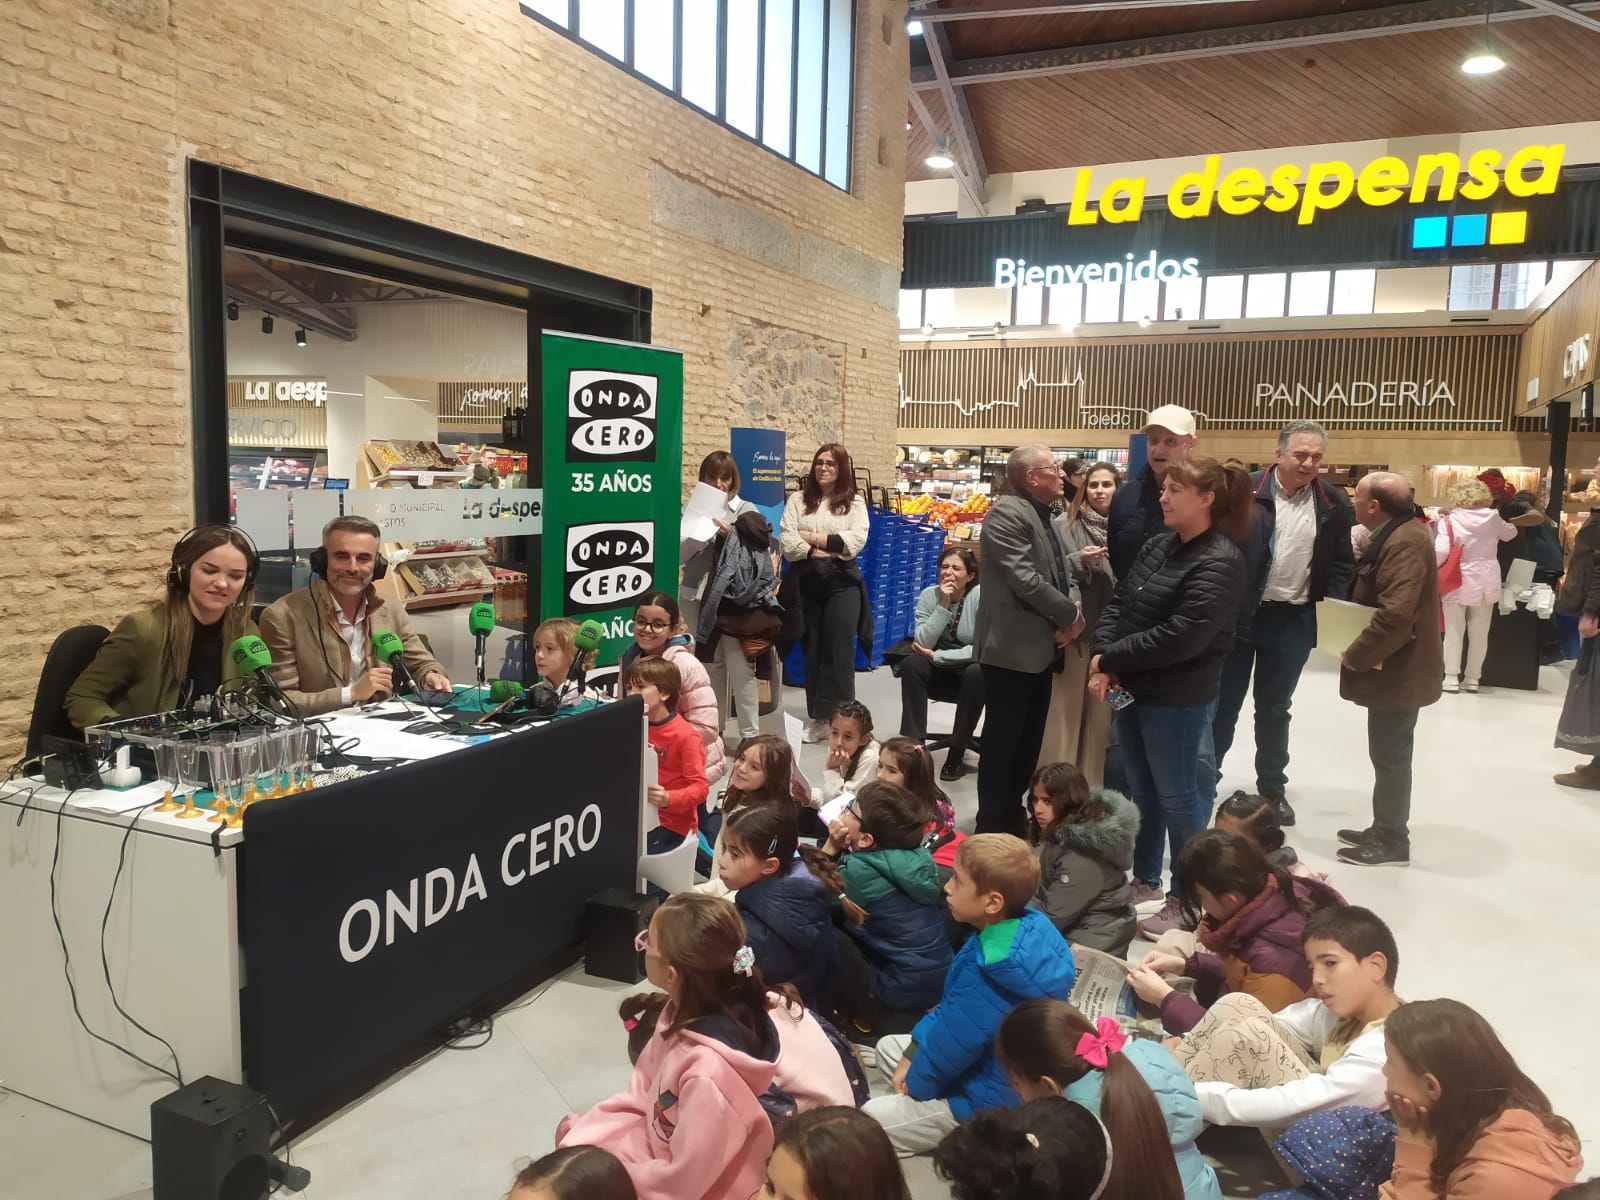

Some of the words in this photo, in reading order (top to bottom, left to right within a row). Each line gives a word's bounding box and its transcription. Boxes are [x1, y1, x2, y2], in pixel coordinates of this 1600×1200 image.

[1068, 167, 1146, 225] La
[1167, 143, 1566, 225] despensa
[995, 250, 1200, 289] Bienvenidos
[275, 381, 327, 407] desp
[581, 388, 645, 409] ONDA
[1255, 378, 1456, 407] PANADERÍA
[1080, 410, 1130, 426] Toledo
[584, 425, 645, 446] CERO
[571, 472, 595, 492] 35
[598, 468, 652, 493] AÑOS
[489, 497, 543, 522] despe
[579, 539, 643, 561] ONDA
[582, 574, 642, 597] CERO
[601, 616, 635, 640] AÑO
[339, 853, 488, 963] ONDA
[501, 803, 602, 887] CERO
